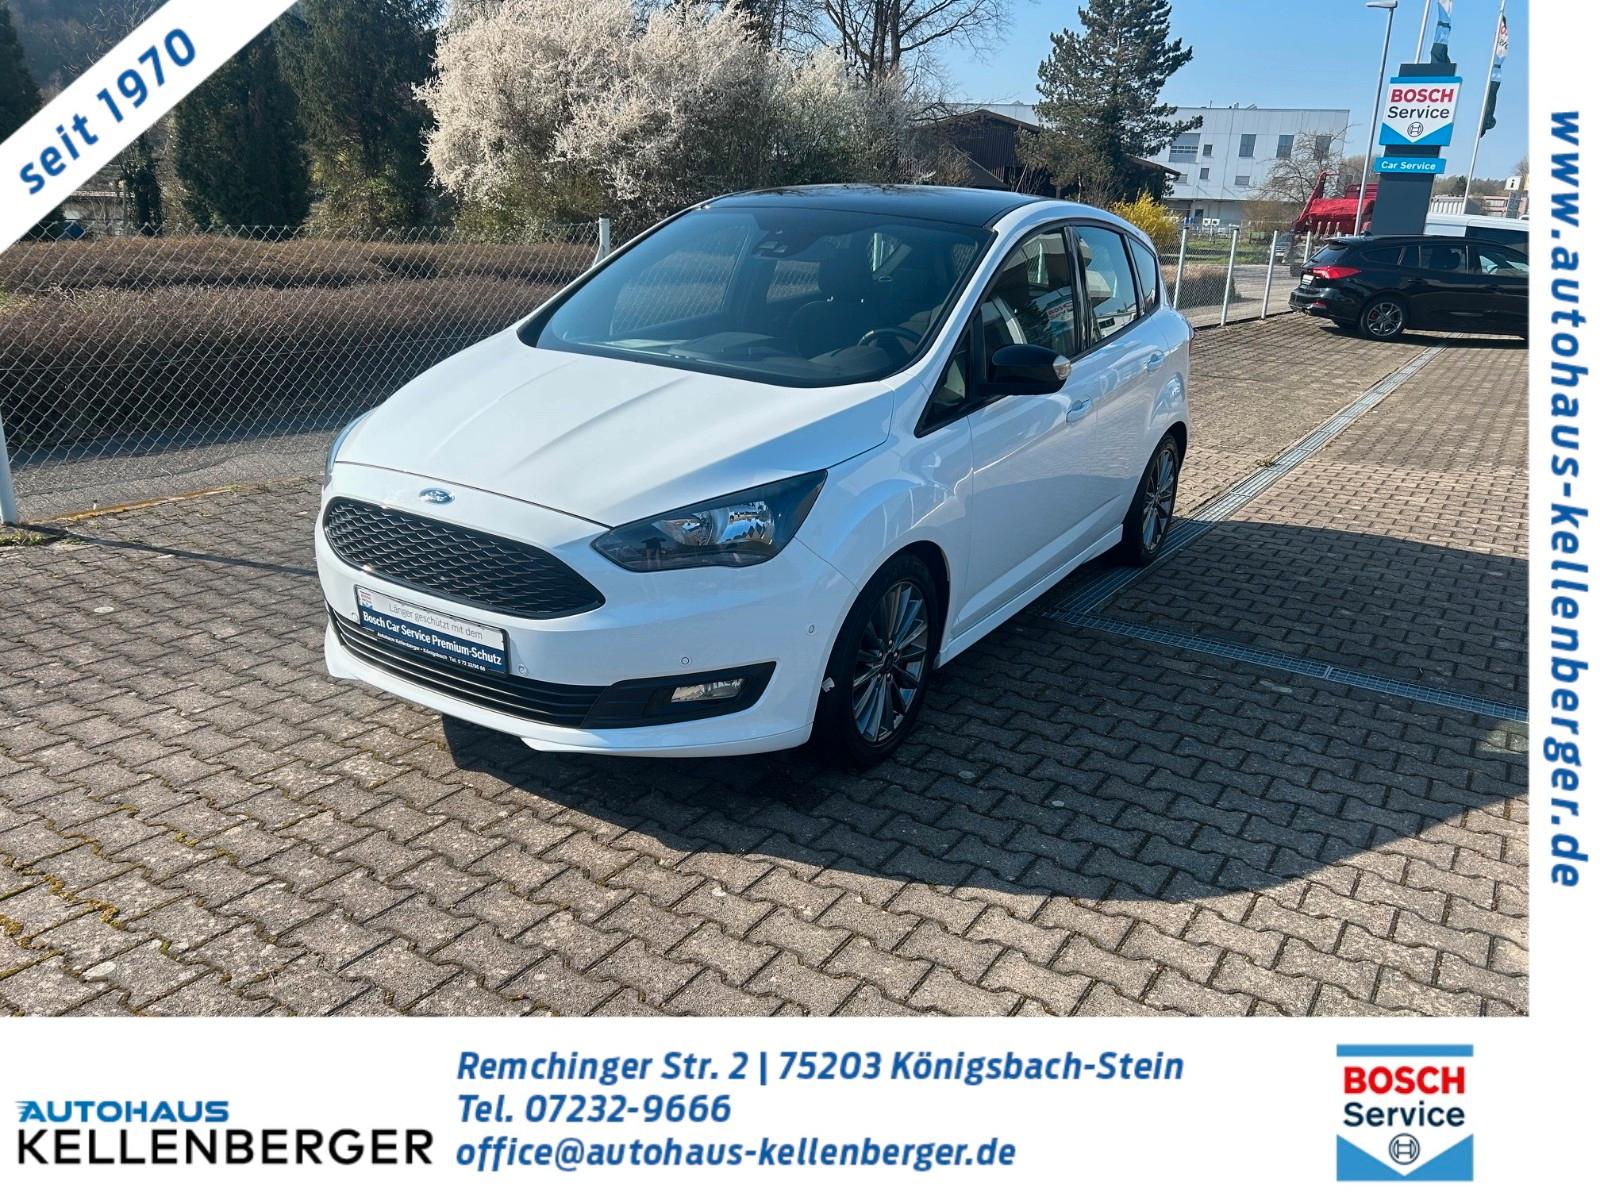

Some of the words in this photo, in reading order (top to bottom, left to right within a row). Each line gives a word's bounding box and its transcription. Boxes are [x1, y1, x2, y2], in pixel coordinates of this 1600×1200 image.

[1390, 88, 1454, 103] BOSCH
[1387, 105, 1450, 119] Service
[1381, 160, 1398, 169] Car
[1400, 160, 1436, 170] Service
[388, 602, 413, 618] Länger
[451, 622, 464, 634] mit
[465, 627, 483, 640] dem
[363, 610, 386, 628] Bosch
[386, 619, 400, 633] Car
[401, 624, 431, 644] Service
[432, 635, 502, 666] Premium-Schutz
